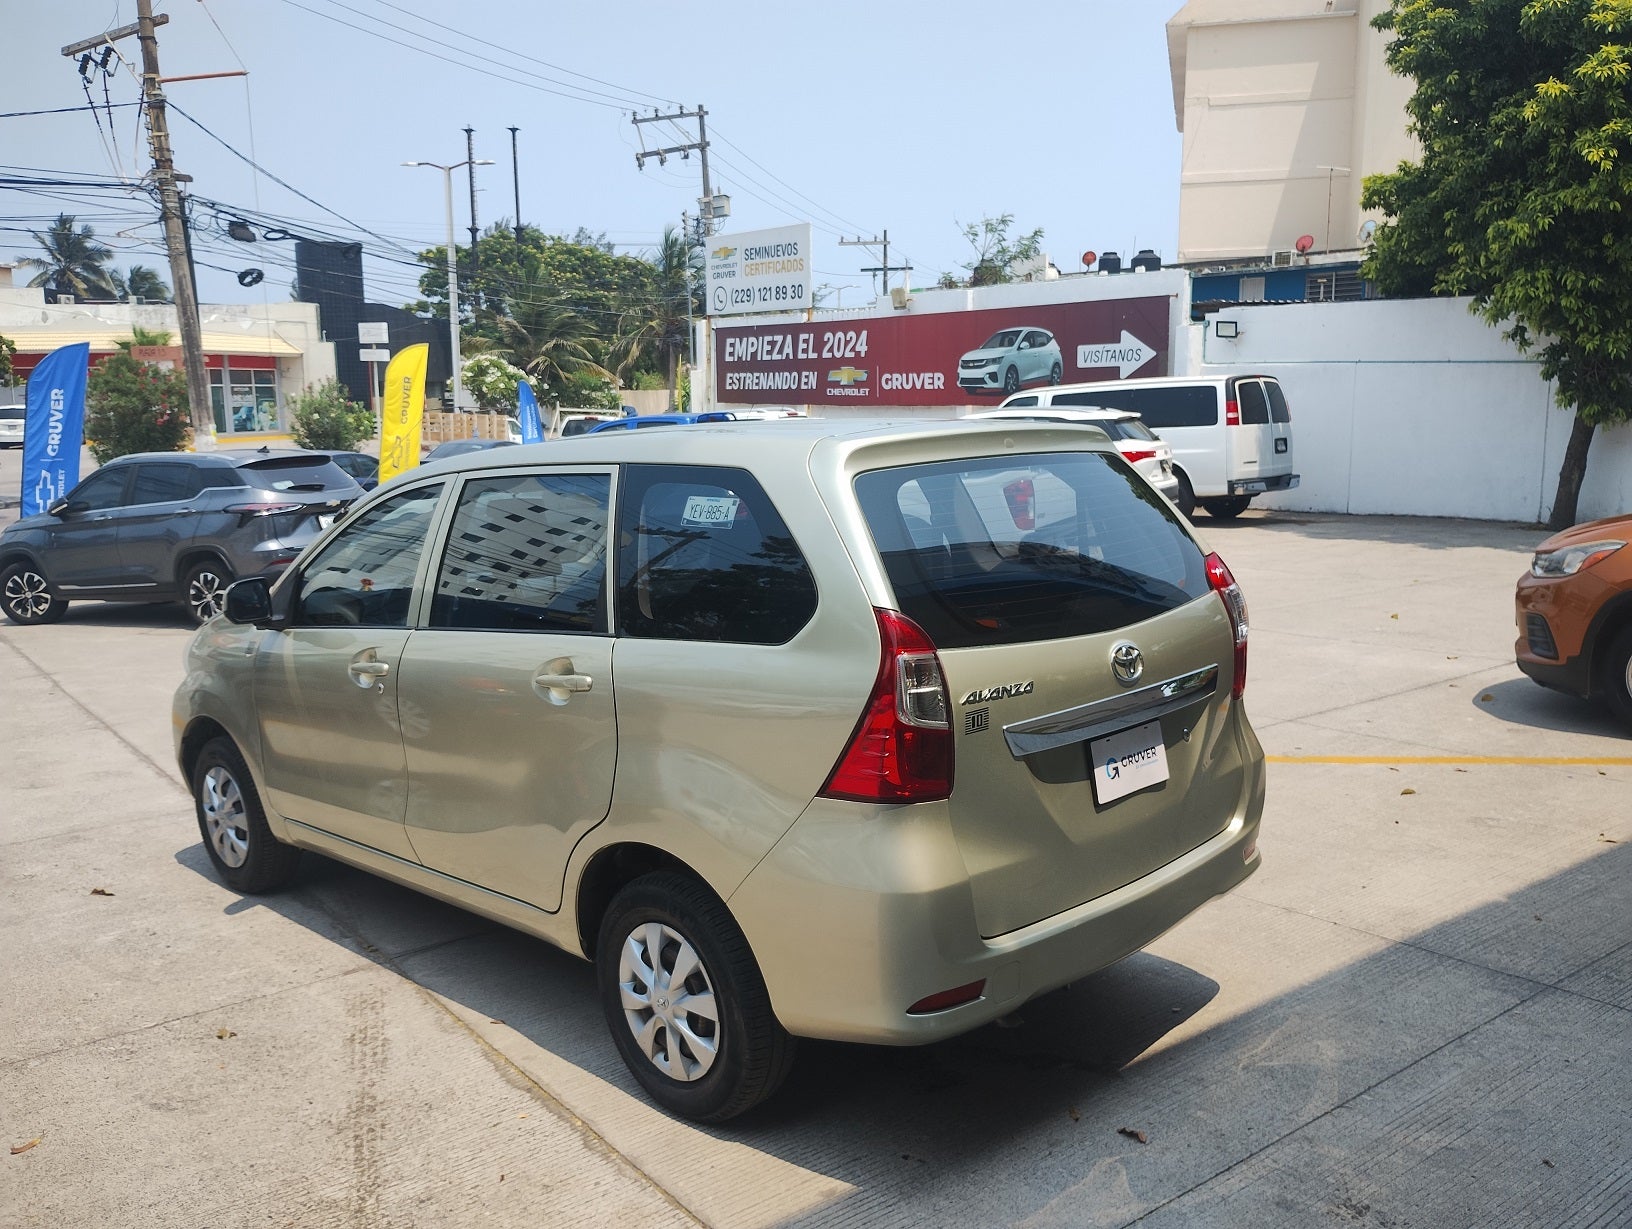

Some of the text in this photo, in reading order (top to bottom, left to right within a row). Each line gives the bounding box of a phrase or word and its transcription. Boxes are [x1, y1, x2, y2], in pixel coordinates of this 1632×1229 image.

[744, 242, 799, 261] SEMINUEVOS
[711, 262, 738, 271] CHEVROLET
[712, 270, 736, 280] GRUVER
[744, 258, 804, 277] CERTIFICADOS
[731, 284, 803, 307] (229) 121 89 30
[724, 330, 868, 362] EMPIEZA EL 2024
[1083, 346, 1142, 363] VISÍTANOS
[725, 371, 818, 390] ESTRENANDO EN
[881, 372, 945, 390] GRUVER
[826, 388, 870, 396] CHEVROLET
[46, 388, 64, 457] GRUVER
[959, 680, 1034, 706] AVANZA
[1120, 746, 1157, 768] GRUVER
